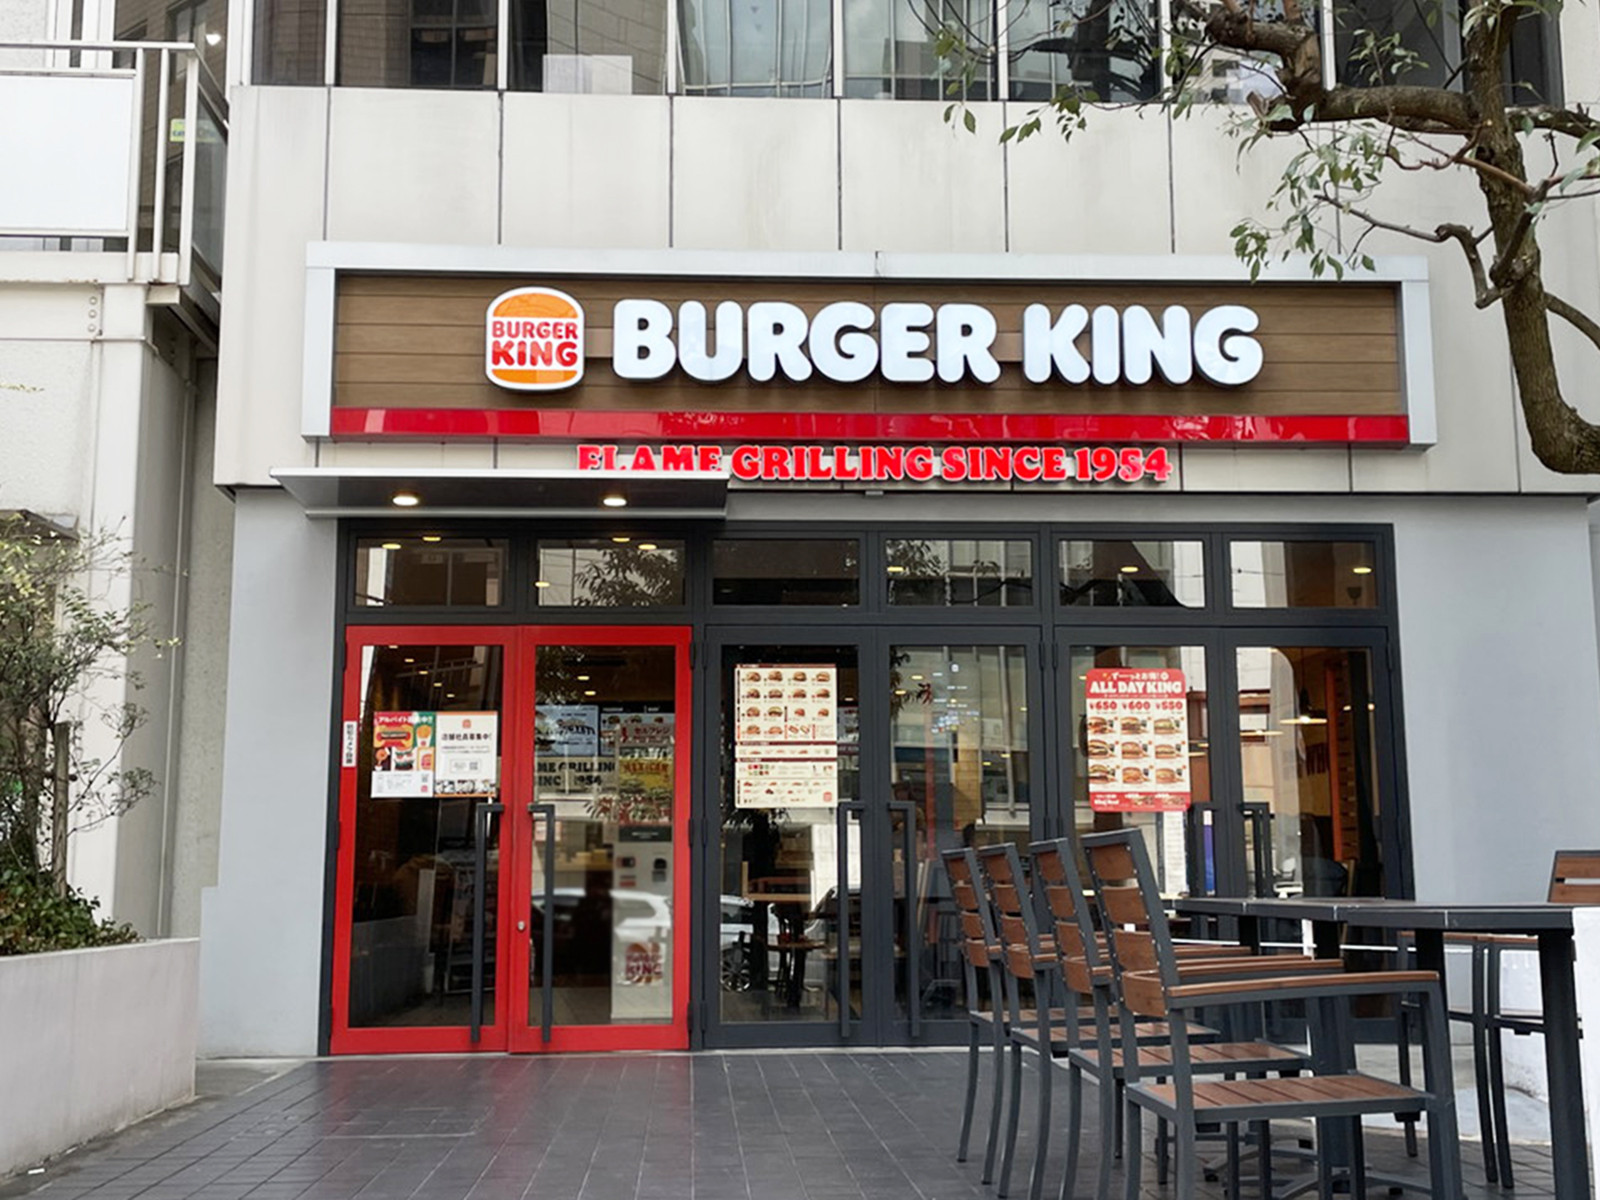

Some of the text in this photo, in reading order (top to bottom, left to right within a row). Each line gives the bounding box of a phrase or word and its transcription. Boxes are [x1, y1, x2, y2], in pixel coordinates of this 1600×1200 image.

[492, 321, 578, 339] BURGER
[613, 299, 1264, 386] BURGER KING
[491, 340, 578, 367] KING
[577, 445, 1172, 482] FLAME GRILLING SINCE 1954
[1090, 681, 1182, 694] ALL DAY KING
